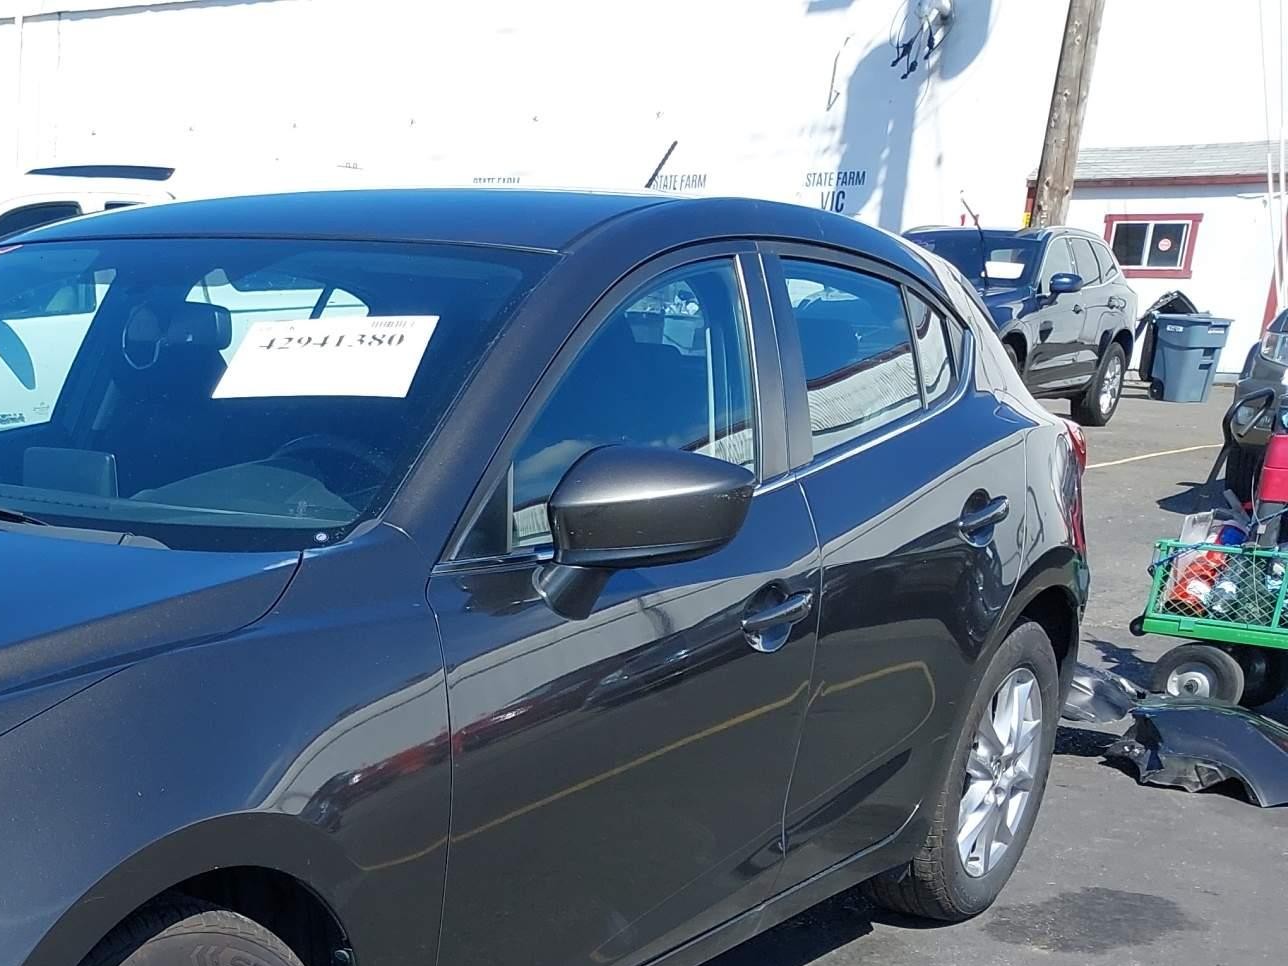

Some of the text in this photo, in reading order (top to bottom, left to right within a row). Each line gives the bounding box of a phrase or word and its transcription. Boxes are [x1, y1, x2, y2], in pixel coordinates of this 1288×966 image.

[653, 174, 707, 191] STATE FARM
[805, 171, 866, 187] STATE FARM
[820, 190, 846, 213] VIC
[258, 333, 405, 350] 42941380
